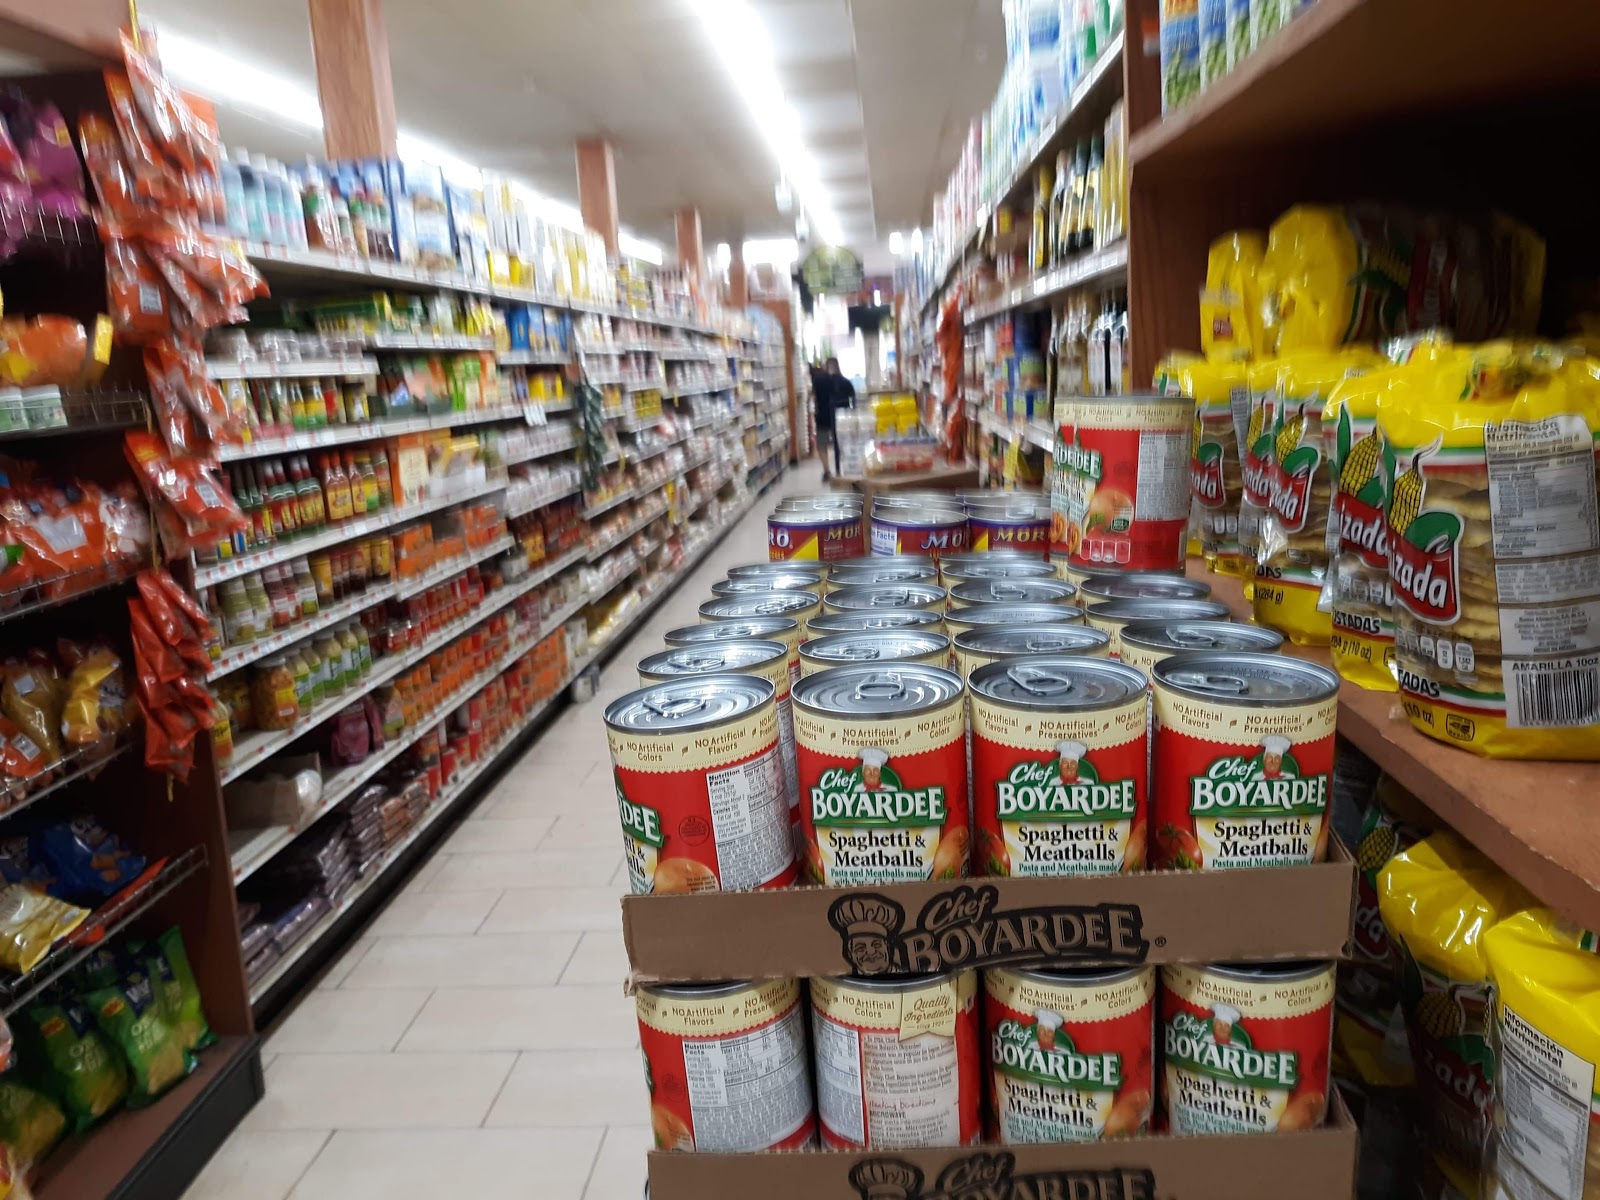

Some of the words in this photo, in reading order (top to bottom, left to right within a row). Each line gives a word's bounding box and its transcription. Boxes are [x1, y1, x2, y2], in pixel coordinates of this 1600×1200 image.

[876, 532, 895, 542] Facts
[1512, 660, 1573, 672] AMARILLA
[1576, 658, 1599, 668] 10oz
[986, 711, 1019, 728] Artificial
[1115, 715, 1126, 725] NO
[1172, 702, 1184, 713] NO
[1184, 706, 1223, 722] Artificial
[1181, 714, 1210, 729] Flavors
[1246, 715, 1261, 724] NO
[1262, 714, 1301, 725] Artificial
[917, 722, 930, 732] NO
[931, 712, 957, 730] Artificial
[985, 720, 1008, 735] Flavors
[1040, 721, 1055, 730] NO
[1056, 720, 1096, 731] Artificial
[695, 739, 709, 749] NO
[710, 729, 747, 746] Artificial
[843, 729, 857, 737] NO
[858, 728, 897, 738] Artificial
[929, 726, 950, 739] Colors
[627, 742, 638, 751] NO
[638, 742, 674, 753] Artificial
[638, 752, 663, 762] Colors
[708, 743, 738, 756] Flavors
[1010, 761, 1053, 786] Chef
[1209, 757, 1258, 782] Chef
[820, 770, 858, 793] Chef
[998, 780, 1136, 815] BOYARDEE
[1192, 775, 1328, 810] BOYARDEE
[812, 787, 945, 822] BOYARDEE
[1018, 824, 1104, 847] Spaghetti
[1108, 828, 1118, 842] &
[1214, 819, 1300, 841] Spaghetti
[1303, 823, 1312, 836] &
[829, 829, 912, 851] Spaghetti
[914, 833, 926, 848] &
[1218, 838, 1308, 858] Meatballs
[835, 851, 924, 868] Meatballs
[1024, 844, 1116, 863] Meatballs
[1212, 859, 1234, 868] Pasta
[1236, 858, 1252, 868] and
[1254, 858, 1292, 867] Meatballs
[831, 868, 849, 878] Pasta
[850, 868, 863, 878] and
[866, 868, 904, 879] Meatballs
[906, 869, 927, 879] made
[1019, 863, 1039, 873] Pasta
[1040, 863, 1054, 873] and
[1058, 863, 1097, 873] Meatballs
[1099, 863, 1118, 872] made
[924, 892, 990, 932] Chef
[904, 908, 1141, 971] BOYARDEE
[745, 995, 758, 1008] NO
[759, 983, 787, 1004] Artificial
[1021, 986, 1033, 996] NO
[1035, 991, 1073, 1003] Artificial
[1095, 993, 1109, 1002] NO
[1110, 983, 1141, 999] Artificial
[1198, 980, 1211, 991] NO
[1212, 984, 1252, 999] Artificial
[1274, 990, 1289, 999] NO
[1290, 981, 1321, 998] Artificial
[842, 995, 855, 1006] NO
[856, 999, 895, 1010] Artificial
[913, 995, 950, 1010] Quality
[1108, 997, 1132, 1009] Colors
[1287, 996, 1312, 1007] Colors
[672, 1008, 685, 1017] NO
[686, 1006, 725, 1017] Artificial
[684, 1016, 715, 1026] Flavors
[854, 1008, 882, 1018] Colors
[904, 1008, 954, 1024] Ingredients
[999, 1022, 1032, 1047] Chef
[1173, 1015, 1207, 1039] Chef
[1505, 1007, 1564, 1060] Información
[1505, 1018, 1562, 1068] Nutrimental
[992, 1033, 1120, 1086] BOYARDEE
[1165, 1025, 1295, 1085] BOYARDEE
[1004, 1078, 1081, 1109] Spaghetti
[1086, 1097, 1098, 1111] &
[1176, 1070, 1255, 1104] Spaghetti
[1260, 1094, 1272, 1109] &
[1008, 1097, 1094, 1128] Meatballs
[1179, 1089, 1267, 1127] Meatballs
[1036, 1120, 1073, 1135] Meatballs
[1075, 1129, 1096, 1139] made
[950, 1158, 1006, 1191] Chef
[940, 1171, 1148, 1200] ARDEE
